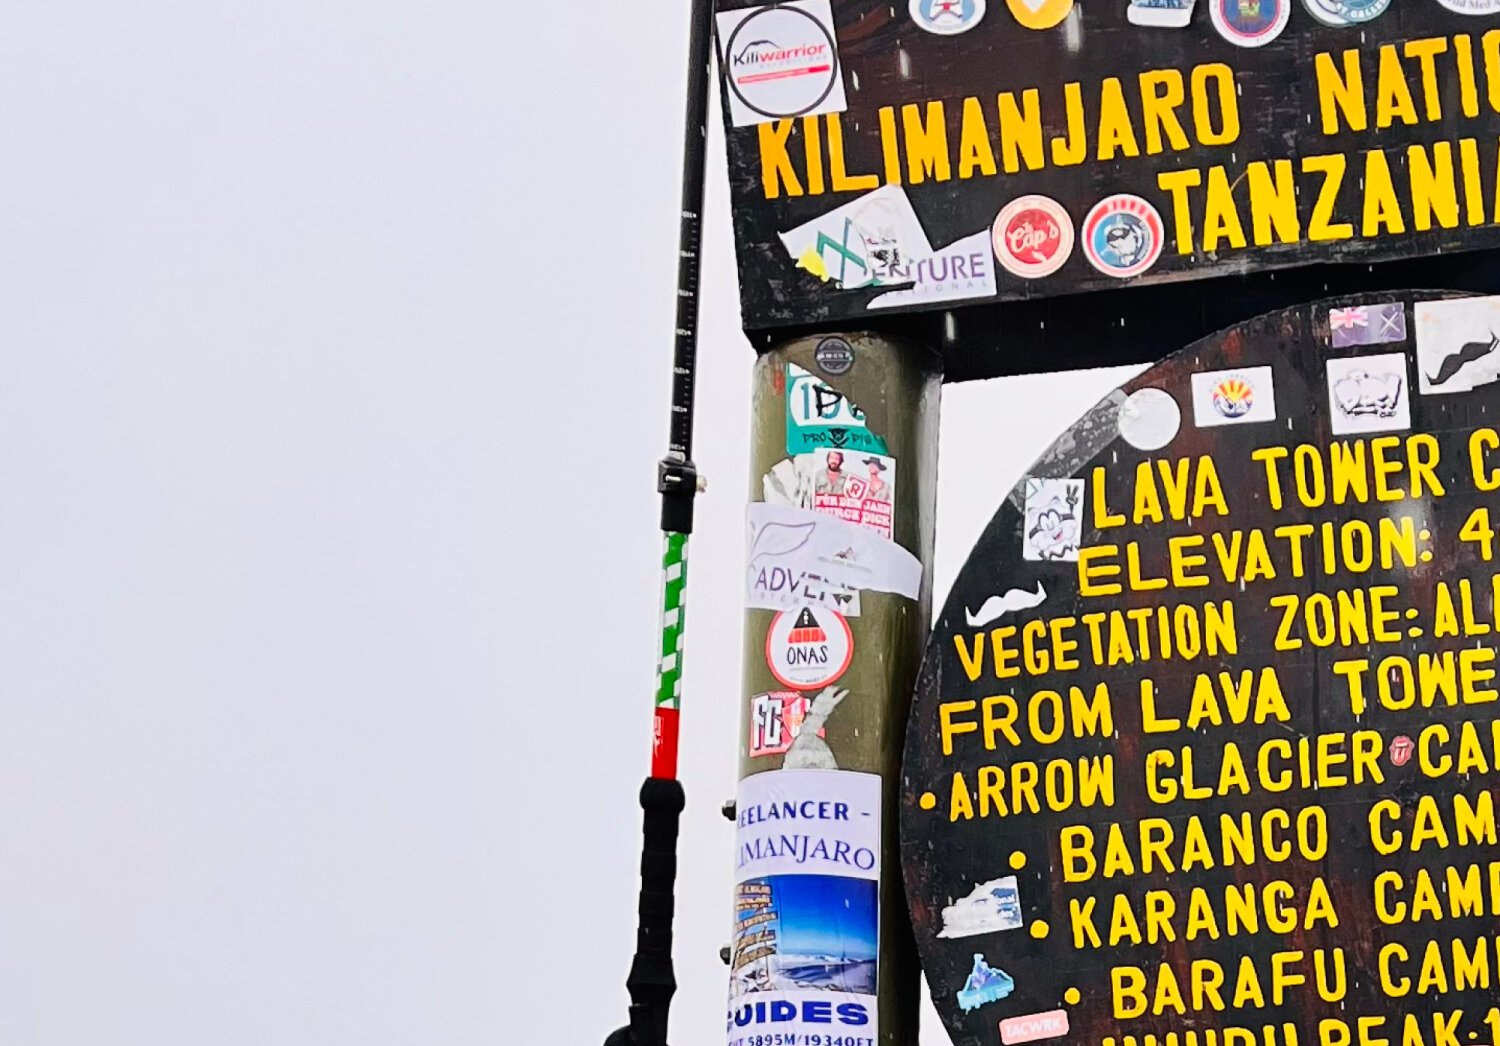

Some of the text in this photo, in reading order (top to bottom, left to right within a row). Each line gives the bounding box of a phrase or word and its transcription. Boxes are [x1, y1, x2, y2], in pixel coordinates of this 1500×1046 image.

[734, 43, 826, 66] Kiliwarrior
[757, 62, 1241, 200] KILIMANJARO
[1092, 454, 1230, 529] LAVA
[1251, 433, 1446, 511] TOWER
[1076, 519, 1434, 597] ELEVATION:
[787, 645, 829, 665] ONAS
[953, 600, 1238, 682] VEGETATION
[939, 682, 1114, 756] FROM
[1141, 667, 1291, 726] LAVA
[949, 755, 1115, 823] ARROW
[1145, 730, 1384, 804] GLACIER
[1059, 805, 1328, 883] BARANCO
[1069, 879, 1339, 949] KARANGA
[1110, 948, 1347, 1020] BARAFU
[1005, 1017, 1061, 1037] TACWRK
